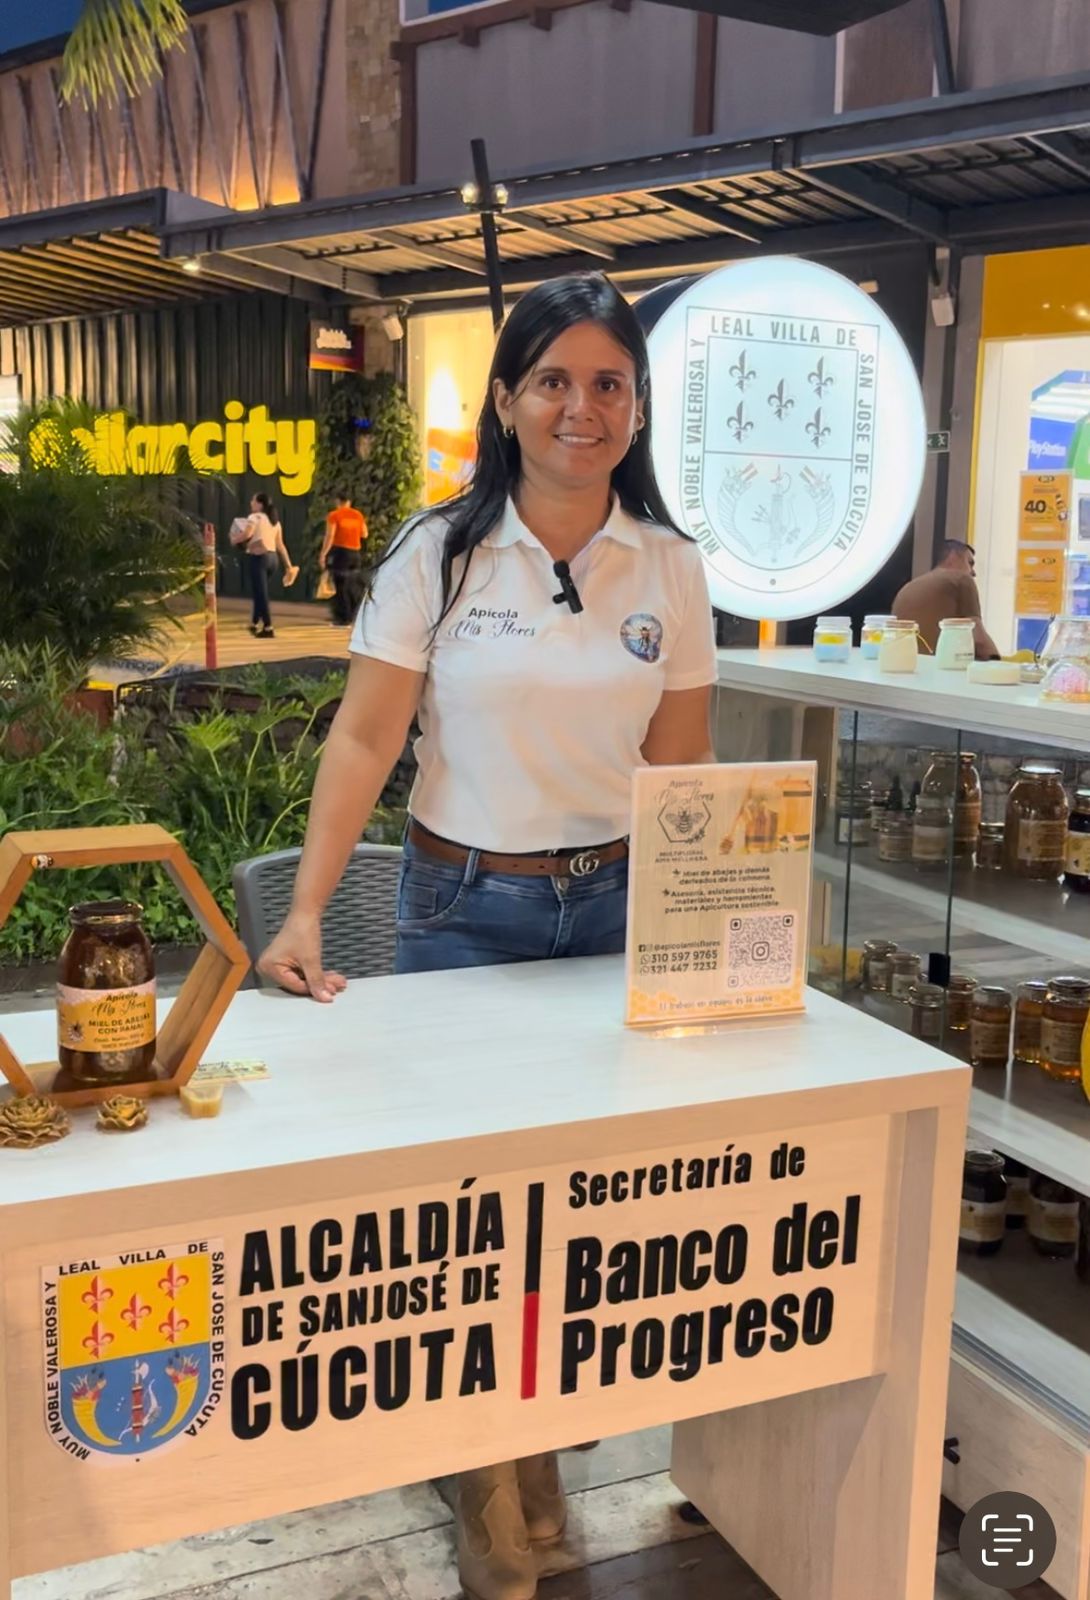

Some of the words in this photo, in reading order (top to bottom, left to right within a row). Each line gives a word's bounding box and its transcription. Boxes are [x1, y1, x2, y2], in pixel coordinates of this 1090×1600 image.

[690, 339, 706, 348] Y
[711, 315, 754, 337] LEAL
[771, 321, 820, 343] VILLA
[836, 328, 857, 346] DE
[859, 354, 874, 388] SAN
[687, 359, 705, 444] VALEROSA
[856, 400, 872, 442] JOSE
[684, 455, 701, 510] NOBLE
[854, 453, 869, 474] DE
[691, 521, 720, 556] MUY
[833, 485, 868, 551] CUCUTA
[492, 618, 536, 638] Flores
[651, 953, 669, 963] 310
[671, 952, 690, 962] 597
[692, 950, 718, 960] 9765
[651, 965, 667, 974] 321
[670, 963, 689, 972] 447
[569, 1144, 752, 1209] Secretaría
[770, 1142, 805, 1180] de
[239, 1177, 505, 1297] ALCALDÍA
[564, 1224, 748, 1315] Banco
[772, 1195, 860, 1277] del
[59, 1260, 100, 1276] LEAL
[119, 1249, 166, 1265] VILLA
[188, 1241, 208, 1255] DE
[212, 1251, 224, 1286] SAN
[45, 1281, 56, 1291] Y
[242, 1300, 283, 1347] DE
[300, 1260, 449, 1337] SANJOSÉ
[462, 1263, 500, 1307] DE
[45, 1293, 58, 1376] VALEROSA
[212, 1291, 224, 1336] JOSE
[211, 1341, 224, 1363] DE
[560, 1287, 834, 1395] Progreso
[184, 1368, 222, 1437] CUCUTA
[230, 1322, 498, 1441] CÚCUTA
[47, 1381, 63, 1434] NOBLE
[59, 1435, 91, 1460] MUY
